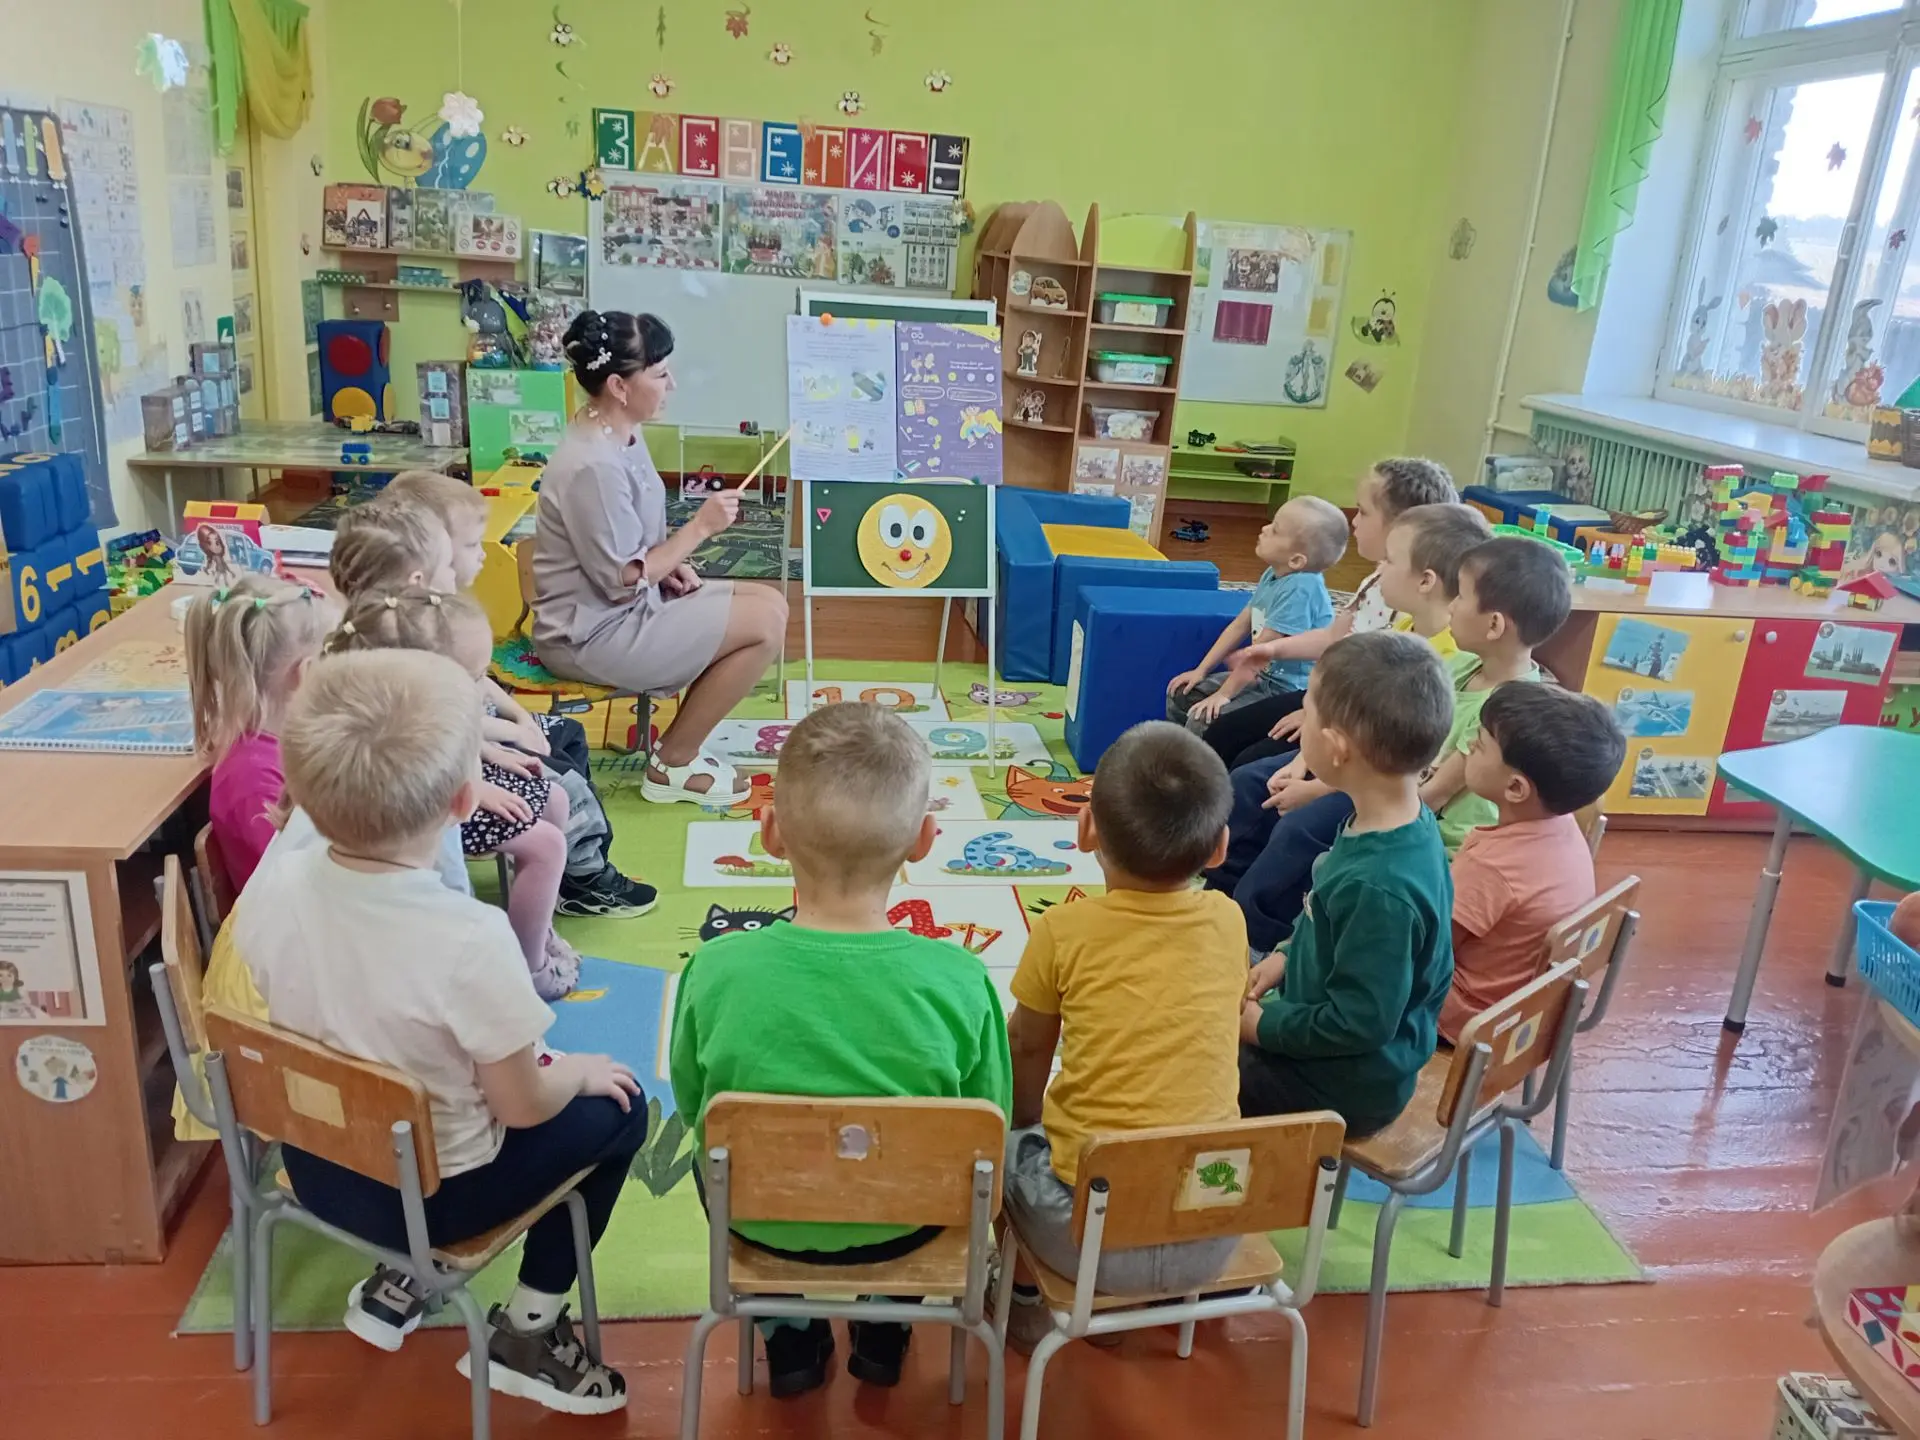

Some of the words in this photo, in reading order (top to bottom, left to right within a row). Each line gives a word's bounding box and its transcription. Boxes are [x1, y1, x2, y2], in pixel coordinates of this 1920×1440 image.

[600, 112, 964, 195] ЗАСВЕТИСЬ
[20, 565, 40, 622] 6
[929, 728, 988, 754] 9
[964, 832, 1037, 872] 6
